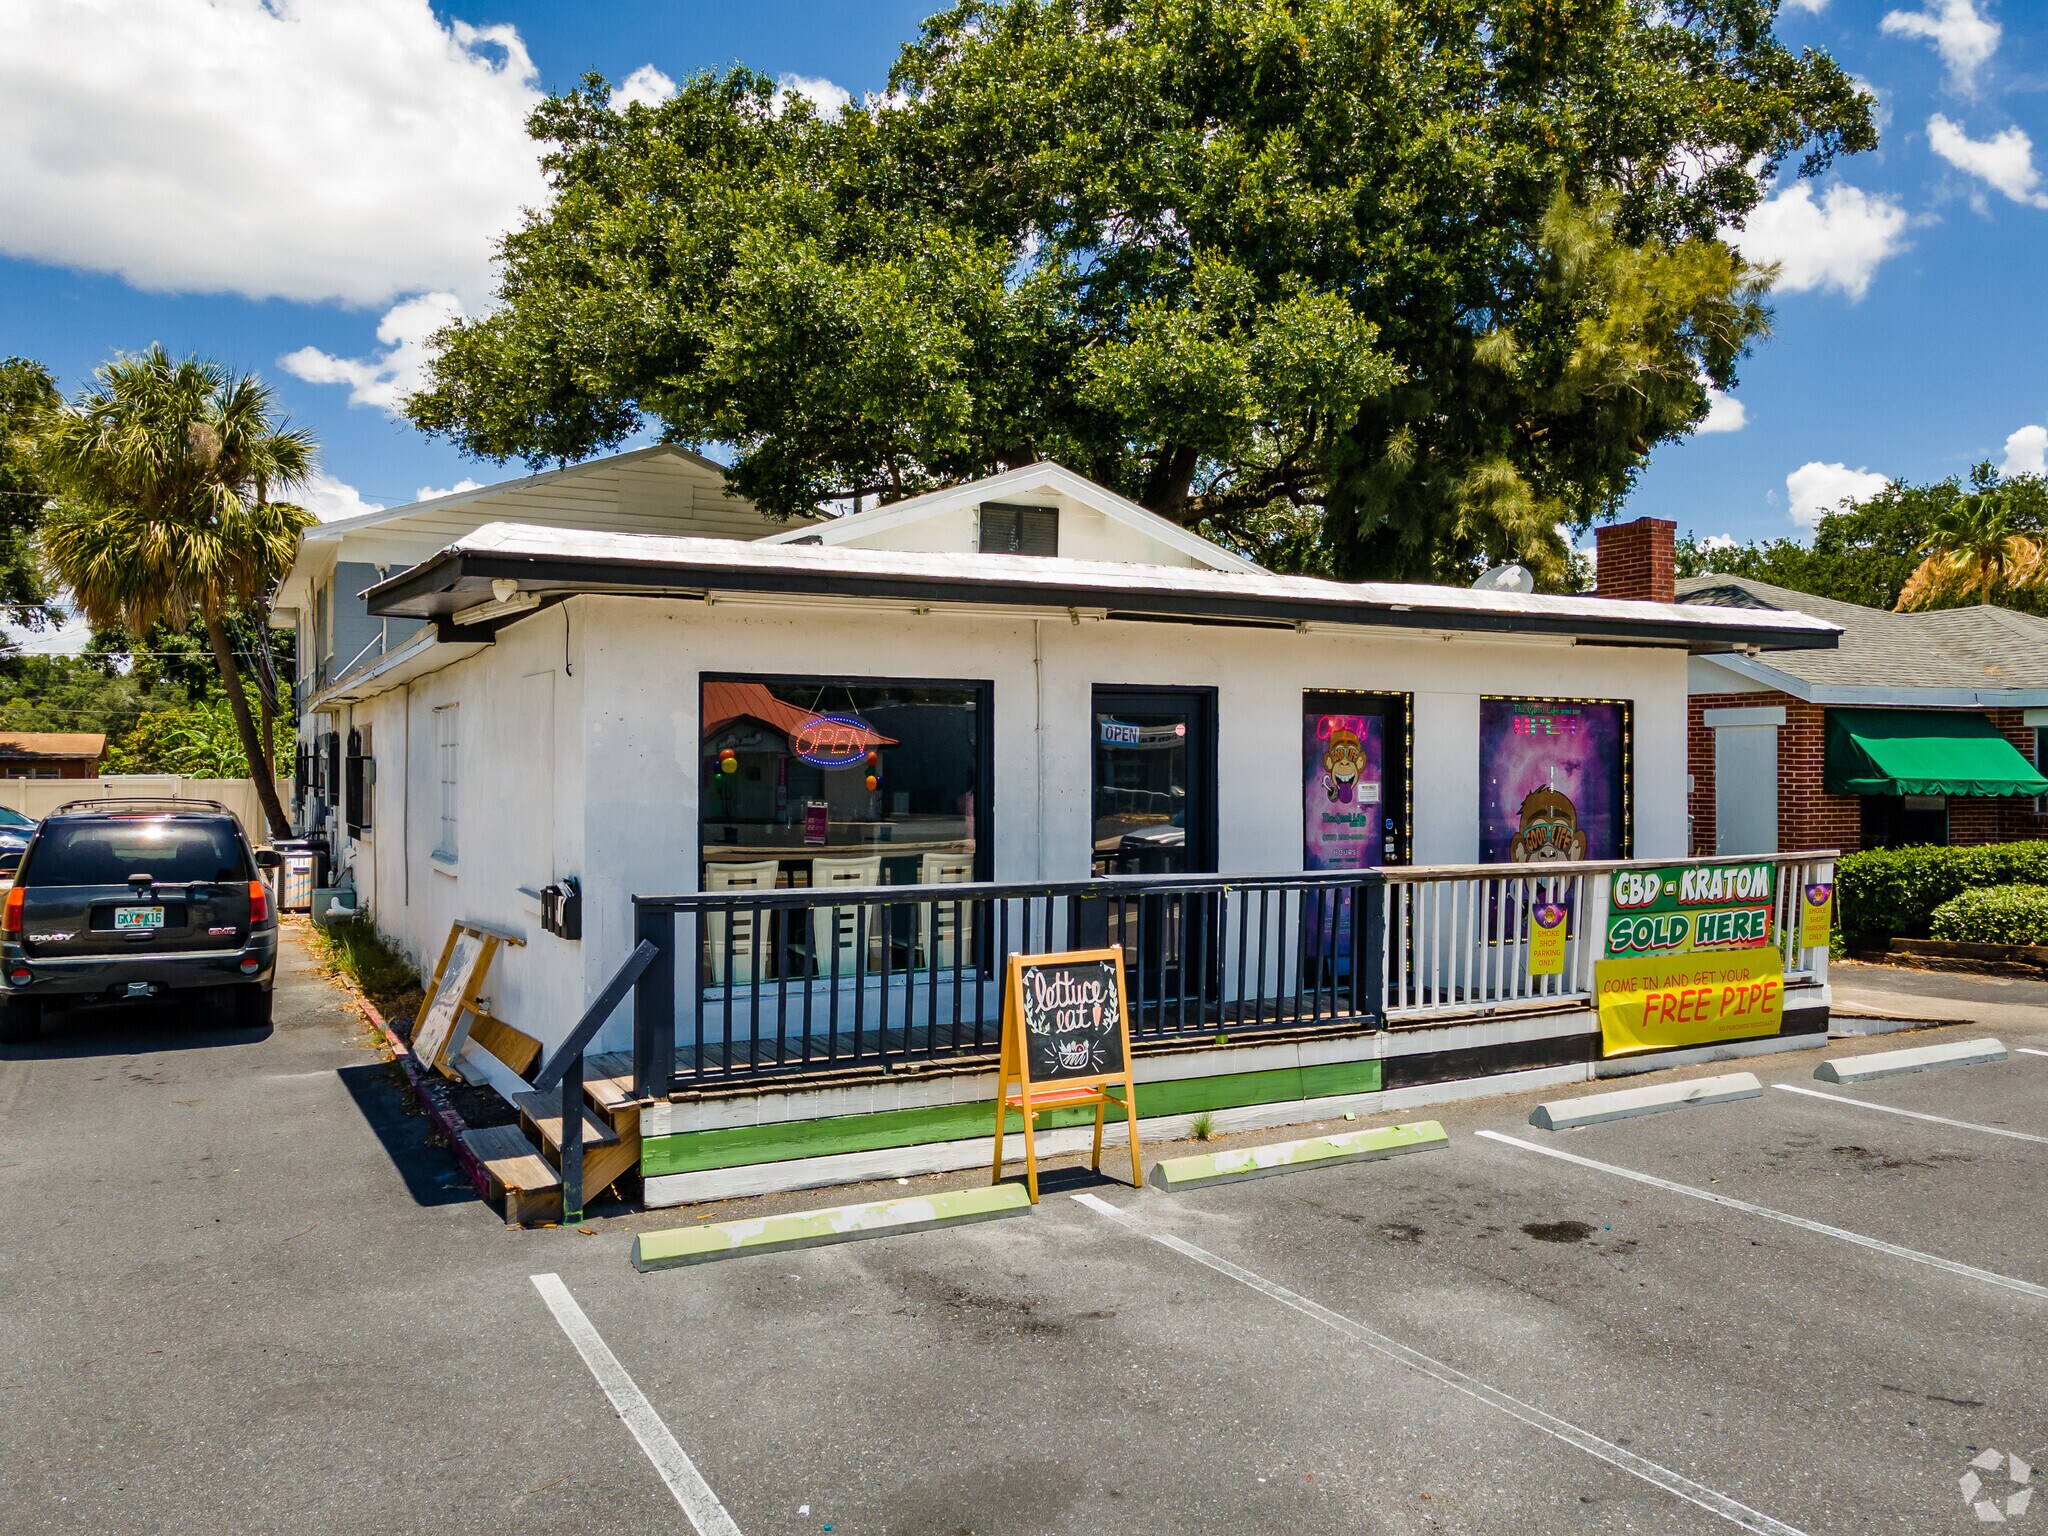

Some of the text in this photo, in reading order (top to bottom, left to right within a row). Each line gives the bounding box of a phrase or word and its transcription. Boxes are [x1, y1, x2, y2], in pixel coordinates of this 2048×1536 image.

[1105, 725, 1138, 743] OPEN
[1316, 715, 1371, 740] OPEN
[796, 727, 871, 755] OPEN
[1526, 826, 1572, 850] GOOD LIFE
[1615, 871, 1662, 908] CBD
[1679, 866, 1769, 903] KRATOM
[1611, 908, 1768, 951] SOLD HERE
[1805, 924, 1828, 932] PARKING
[1810, 915, 1825, 923] SHOP
[29, 933, 76, 942] ENVOY
[1538, 929, 1560, 937] SMOKE
[1534, 949, 1561, 957] PARKING
[1603, 968, 1750, 993] COME IN AND GET YOUR
[1642, 981, 1778, 1028] FREE PIPE
